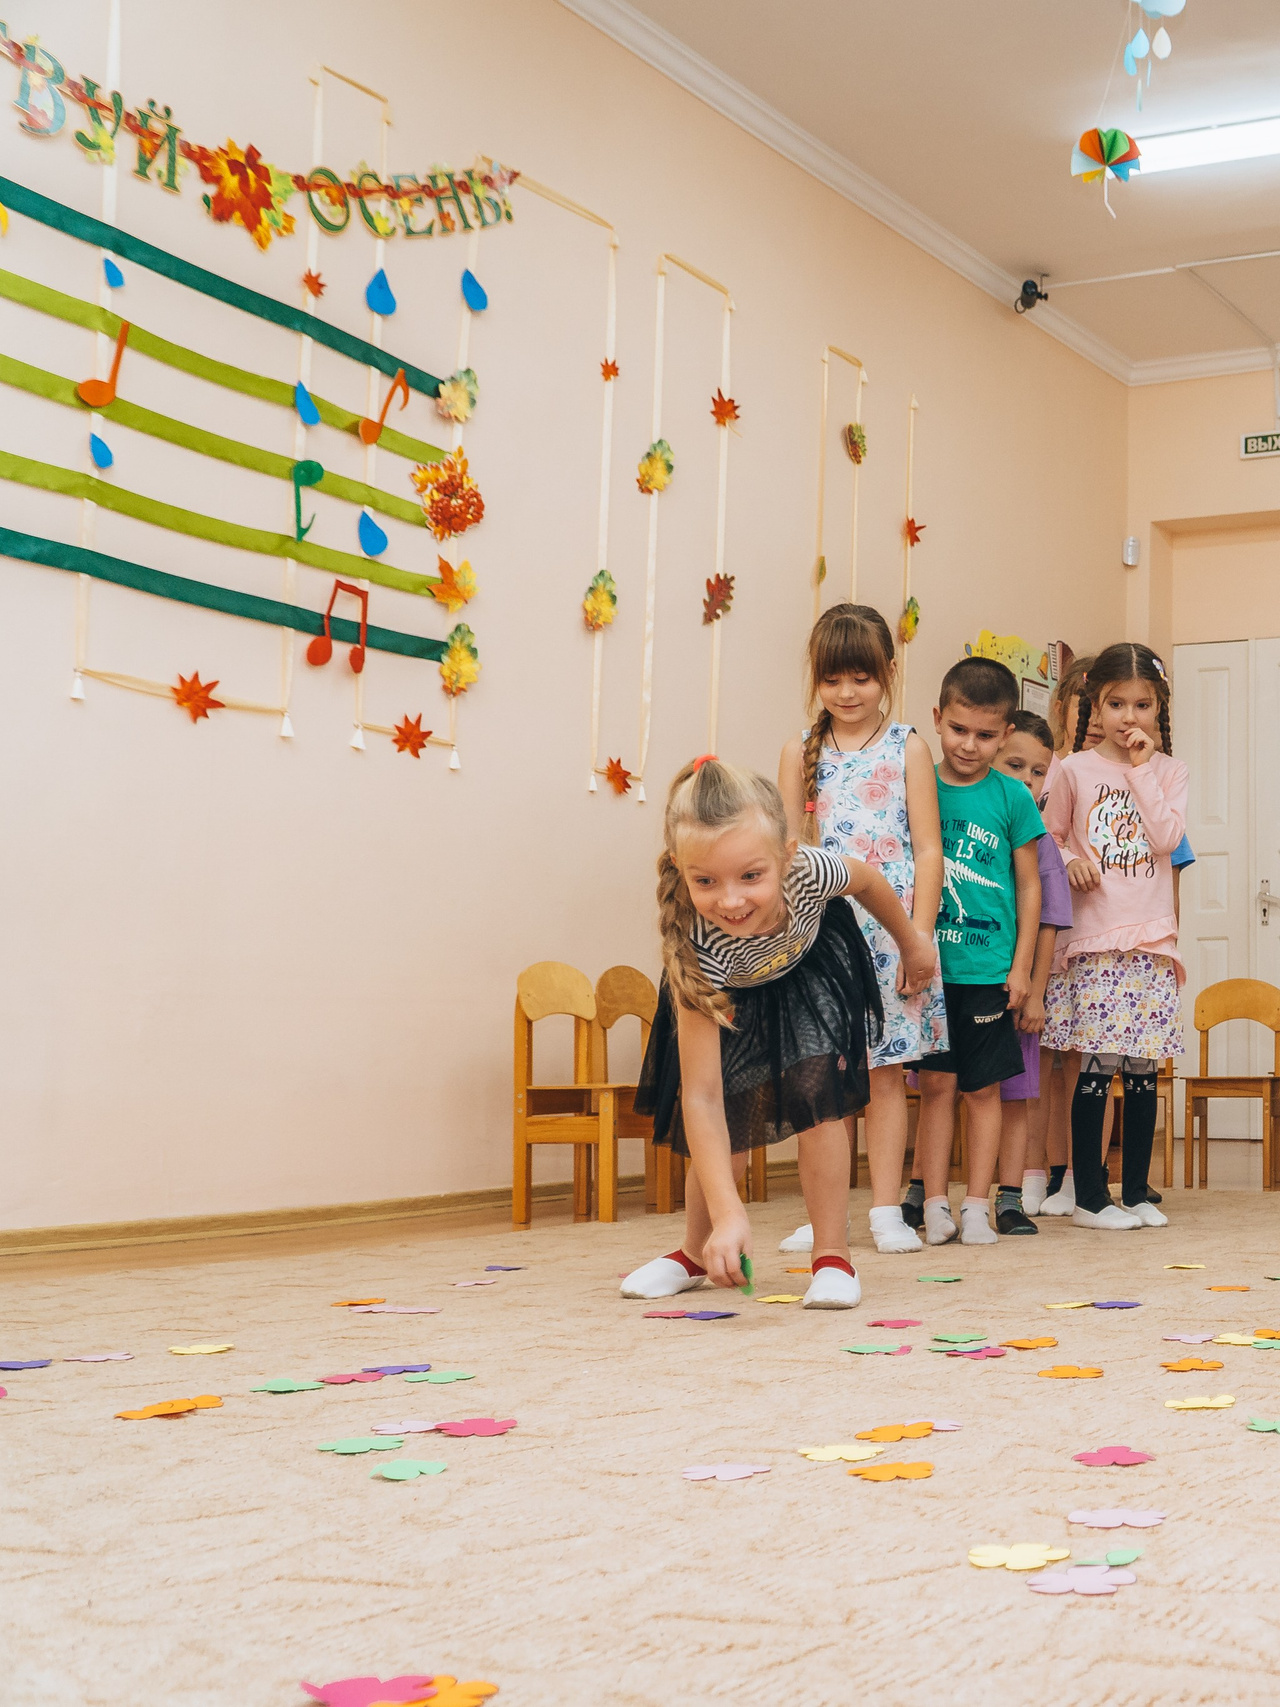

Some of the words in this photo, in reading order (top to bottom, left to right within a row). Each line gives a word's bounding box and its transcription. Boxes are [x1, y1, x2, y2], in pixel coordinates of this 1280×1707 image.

[0, 21, 181, 193] ВУЙ
[952, 819, 967, 832] THE
[966, 821, 1000, 850] LENGTH
[1097, 842, 1158, 879] happy
[936, 928, 963, 944] ETRES
[964, 931, 991, 948] LONG
